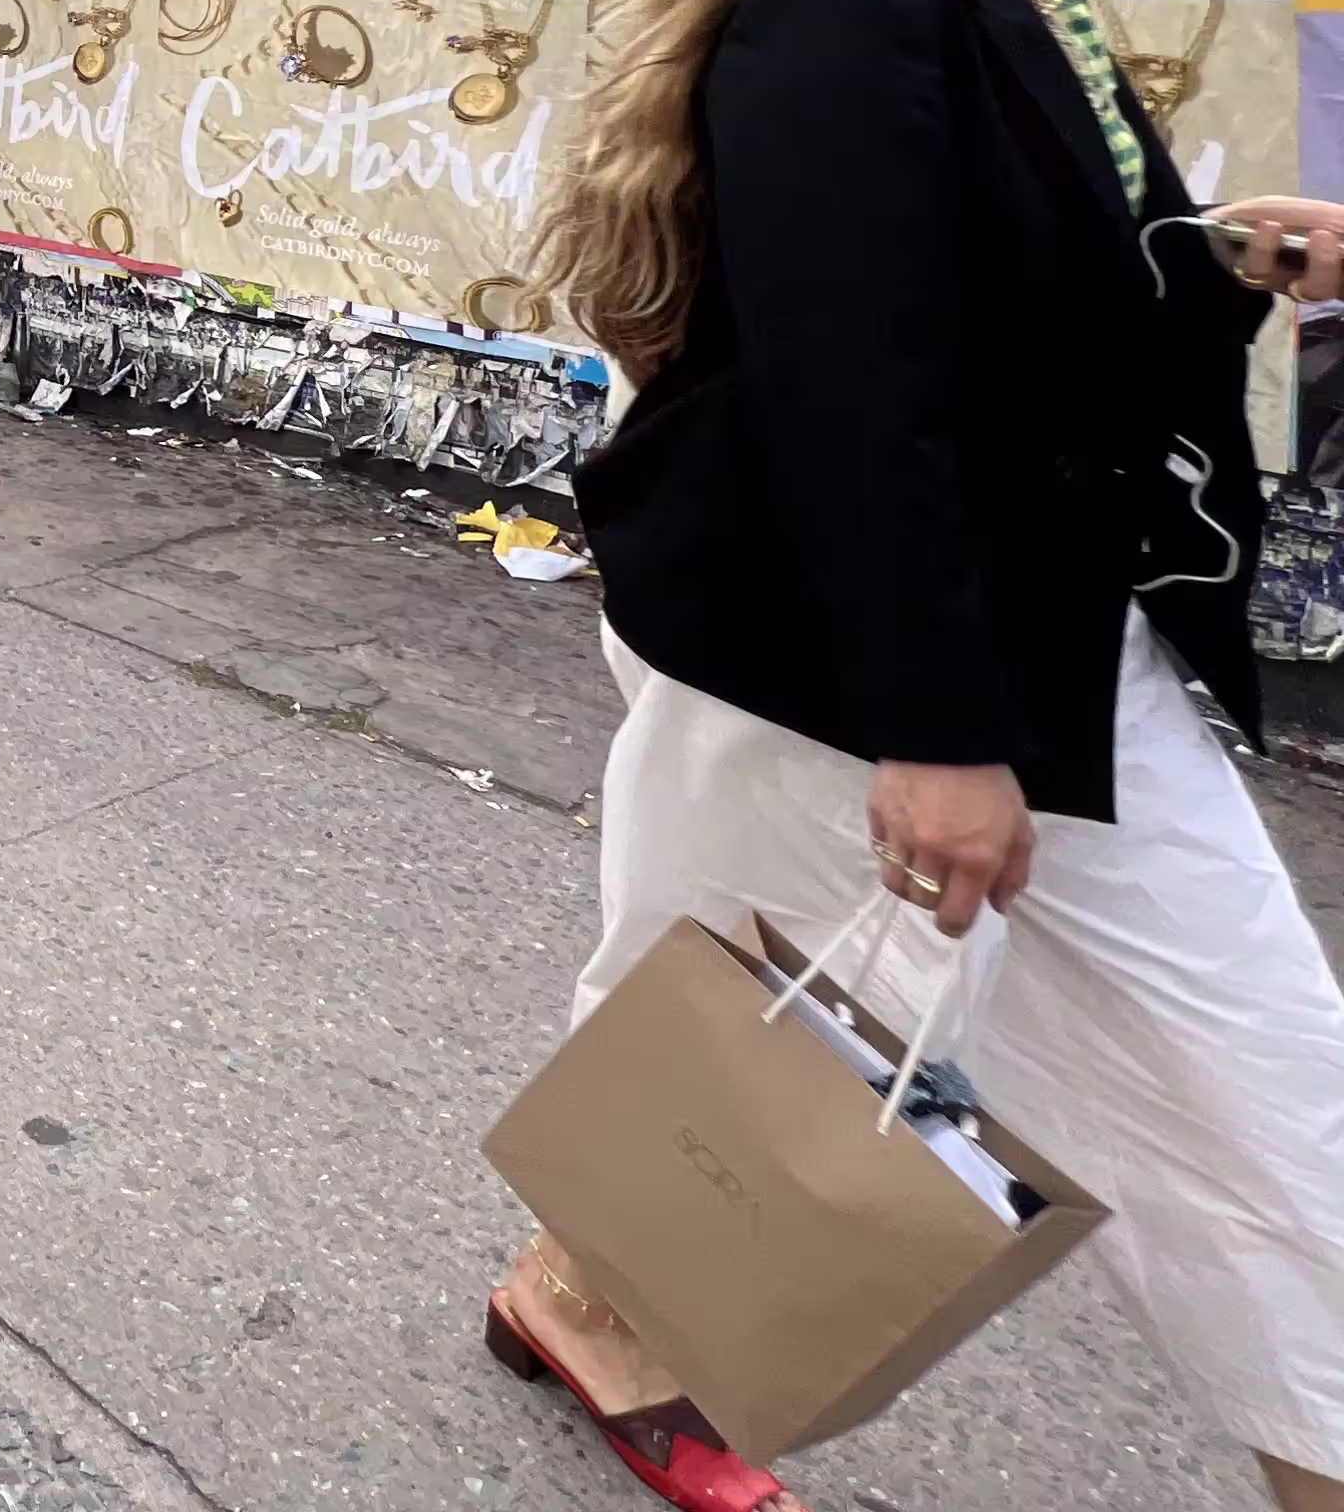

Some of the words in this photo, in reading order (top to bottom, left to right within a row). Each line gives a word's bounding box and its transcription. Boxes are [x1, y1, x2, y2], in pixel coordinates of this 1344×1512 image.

[180, 75, 553, 232] Catbird
[21, 164, 73, 193] always
[256, 204, 308, 229] Solid
[310, 213, 362, 240] gold,
[367, 221, 441, 253] always
[260, 234, 432, 279] CATBIRDNYC.COM
